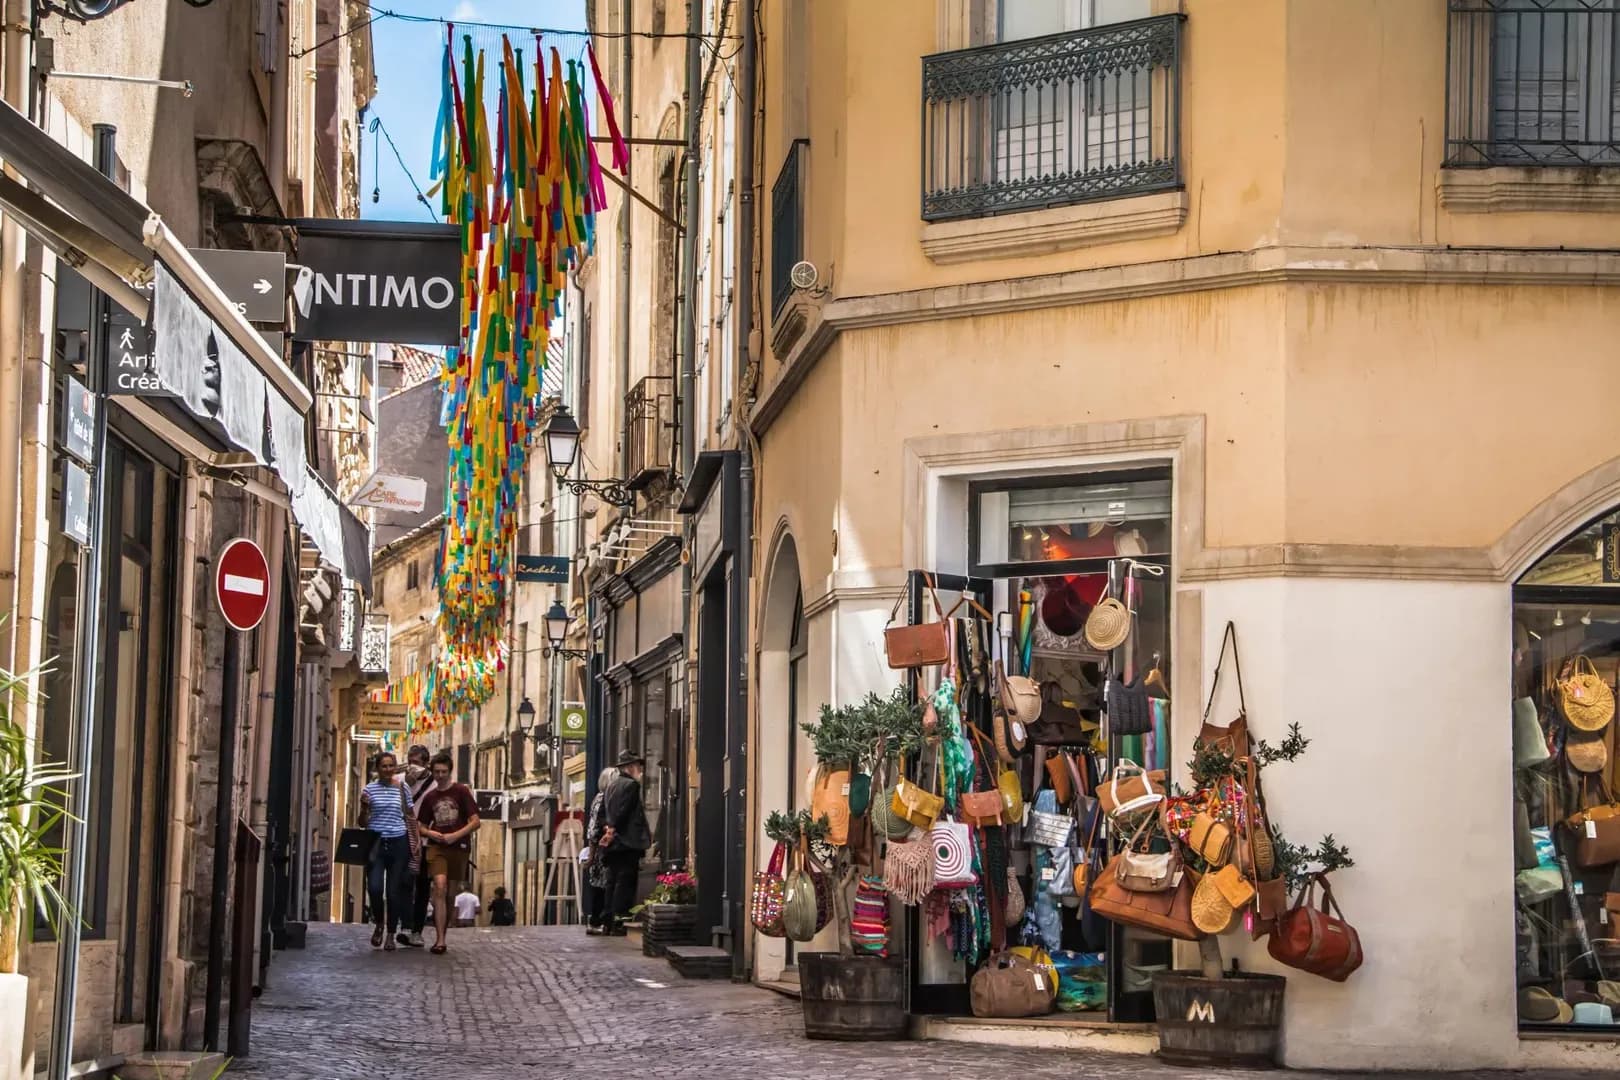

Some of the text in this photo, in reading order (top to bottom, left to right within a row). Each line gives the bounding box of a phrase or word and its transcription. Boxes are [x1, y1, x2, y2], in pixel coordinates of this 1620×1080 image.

[314, 272, 454, 309] NTIMO
[118, 373, 165, 389] Créa
[1186, 999, 1215, 1023] M
